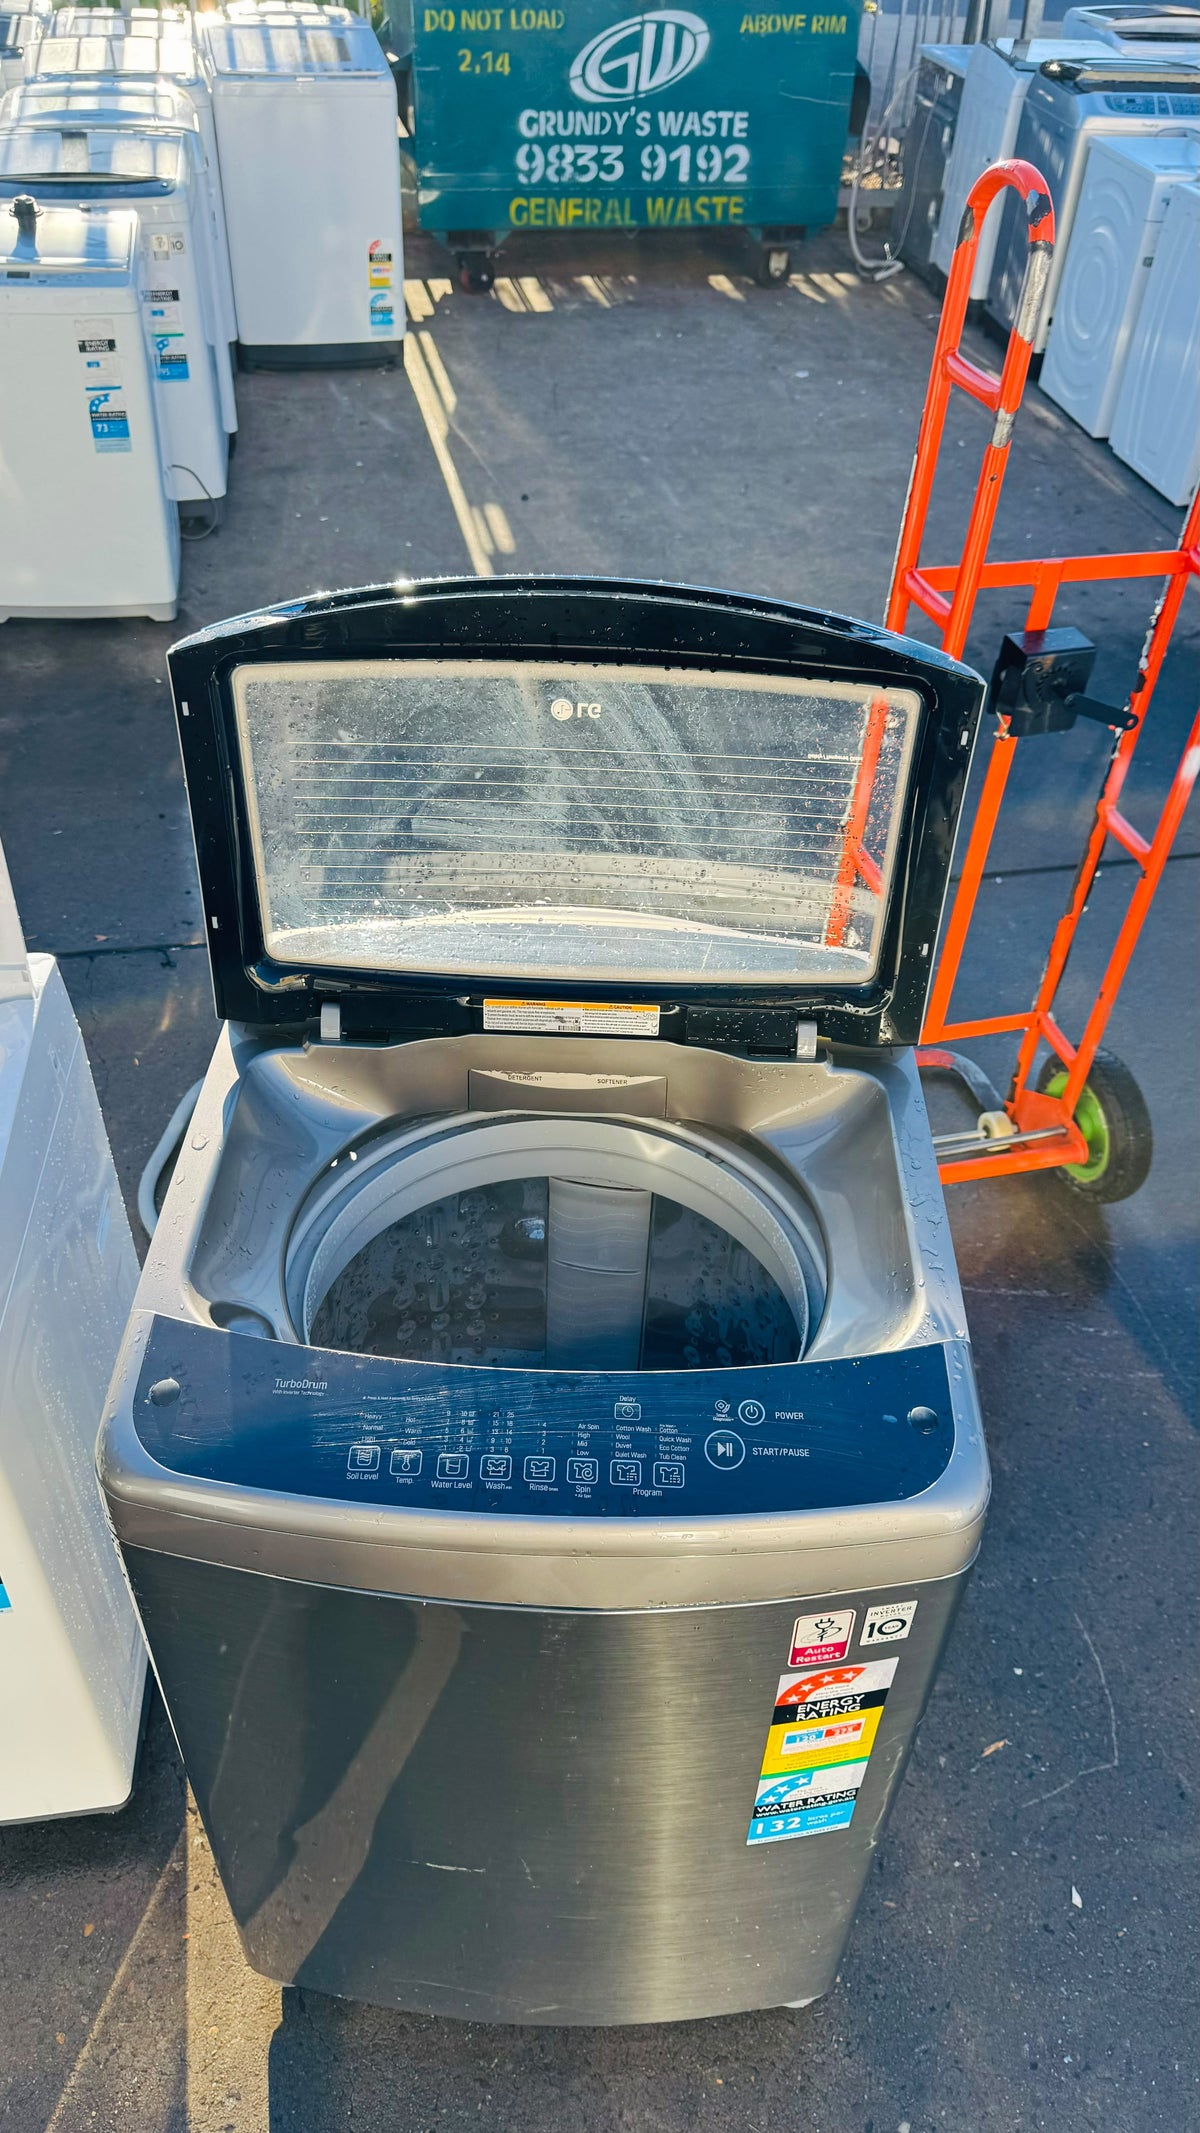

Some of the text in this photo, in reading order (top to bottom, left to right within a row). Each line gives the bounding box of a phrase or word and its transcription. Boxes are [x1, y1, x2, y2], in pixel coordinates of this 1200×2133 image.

[424, 10, 565, 32] DO NOT LOAD
[740, 14, 847, 34] ABOVE RIM
[519, 107, 749, 138] GRUNDY'S WASTE
[516, 143, 750, 184] 9833 9192
[509, 196, 744, 226] GENERAL WASTE
[274, 1378, 328, 1390] TurboDrum
[775, 1412, 804, 1420] POWER
[752, 1448, 810, 1457] START/PAUSE
[530, 1483, 548, 1491] Rinse
[576, 1485, 591, 1493] Spin
[633, 1488, 662, 1497] Program
[868, 1619, 907, 1638] 10
[796, 1652, 841, 1663] Restart
[804, 1646, 834, 1655] Auto
[796, 1703, 861, 1721] RATING
[797, 1694, 865, 1713] ENERGY
[757, 1798, 804, 1812] WATER
[807, 1789, 856, 1807] RATING
